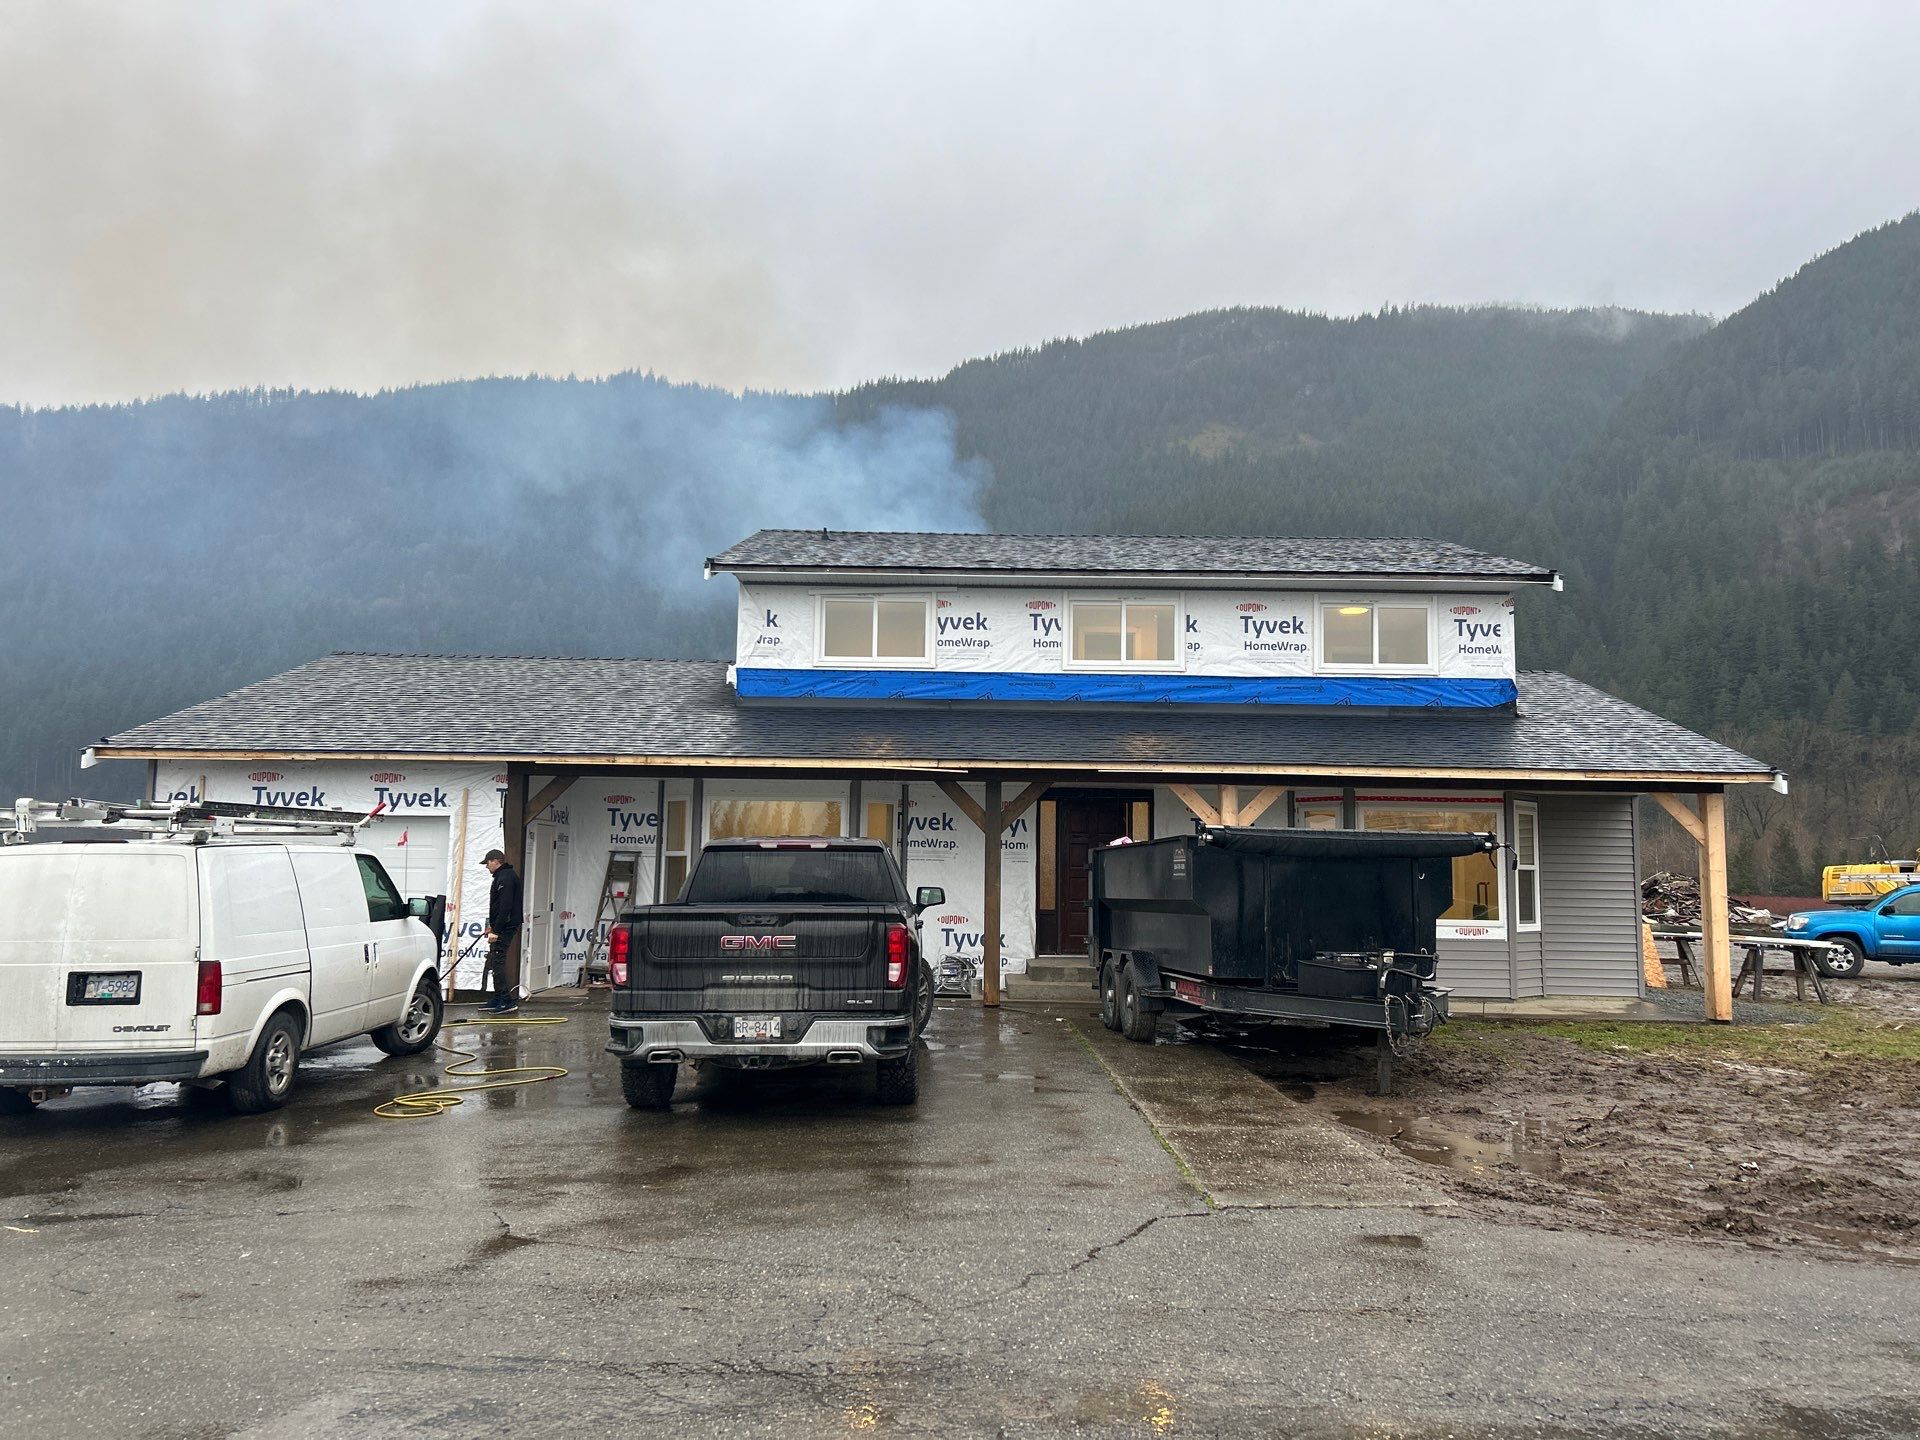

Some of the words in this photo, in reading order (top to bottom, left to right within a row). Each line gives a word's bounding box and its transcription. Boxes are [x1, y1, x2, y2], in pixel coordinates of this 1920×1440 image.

[1028, 601, 1053, 610] DUPONT
[1239, 603, 1264, 612] DUPONT
[1453, 606, 1478, 615] DUPONT
[937, 612, 988, 635] yvek
[1029, 613, 1061, 636] Tyv
[1240, 615, 1304, 638] Tyvek
[1454, 619, 1501, 642] Tyve
[937, 637, 990, 649] omeWrap
[1244, 641, 1307, 653] HomeWrap
[1458, 644, 1502, 654] HomeW
[252, 771, 281, 782] DUPONT
[374, 773, 402, 783] DUPONT
[374, 787, 447, 812] Tyvek
[607, 795, 633, 804] DUPONT
[607, 808, 659, 832] Tyve
[610, 834, 657, 844] HomeW
[941, 915, 966, 924] DUPONT
[720, 935, 797, 950] GMC
[112, 1024, 171, 1033] CHEVROLET
